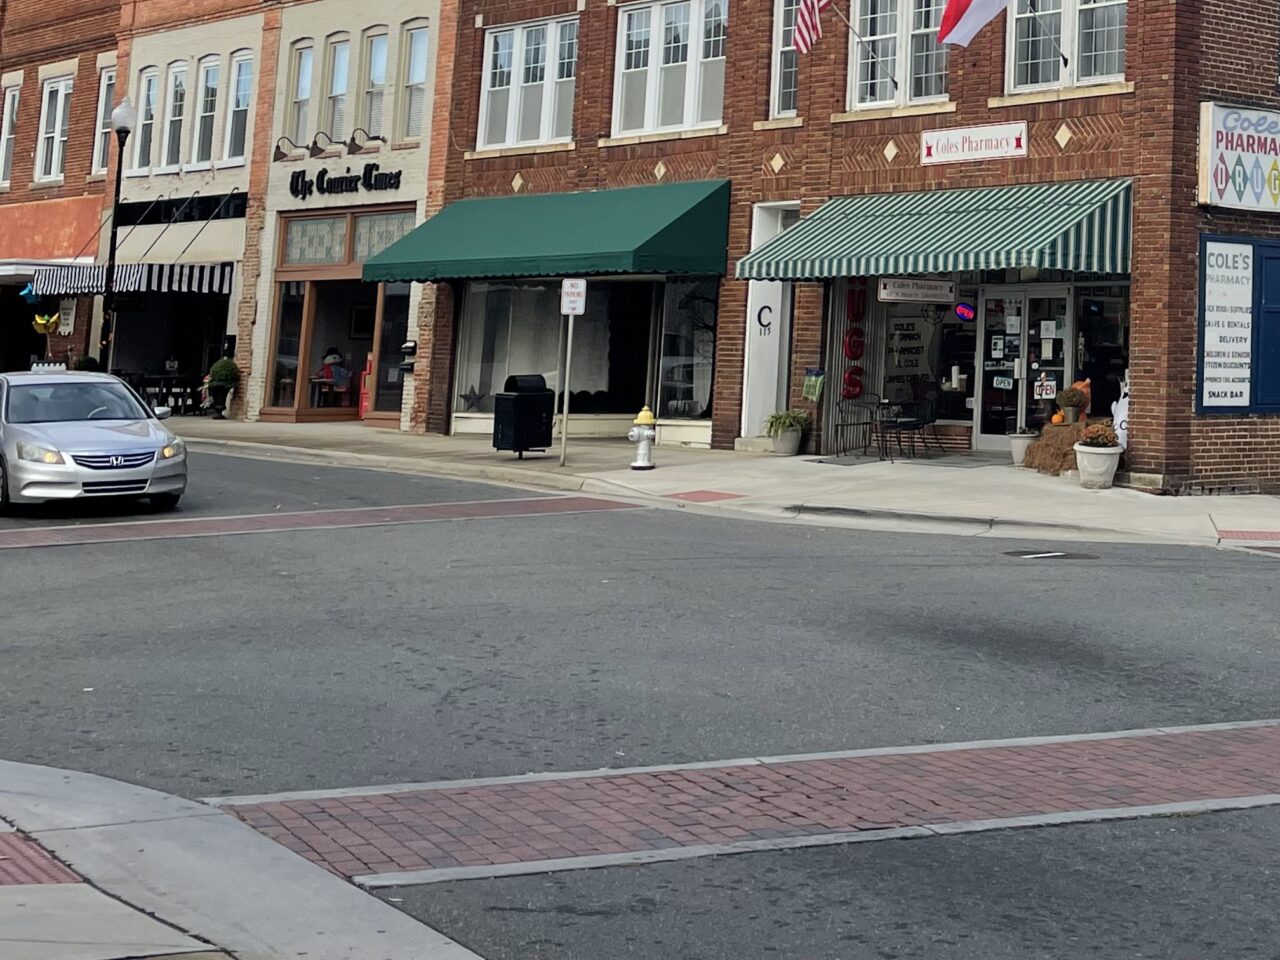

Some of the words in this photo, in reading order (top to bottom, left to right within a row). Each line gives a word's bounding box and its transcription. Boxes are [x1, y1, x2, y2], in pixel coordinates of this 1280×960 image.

[936, 137, 959, 156] Coles
[961, 135, 1011, 154] Pharmacy
[289, 169, 314, 200] The
[1207, 252, 1251, 270] COLE'S
[1206, 273, 1251, 286] PHARMACY
[757, 305, 773, 328] C
[1227, 321, 1250, 329] RENTALS
[843, 275, 866, 400] UGS
[1219, 336, 1248, 344] DELIVERY
[995, 377, 1012, 388] OPEN
[1035, 383, 1055, 396] OPEN
[1208, 390, 1229, 399] SNACK
[1230, 390, 1244, 399] BAR
